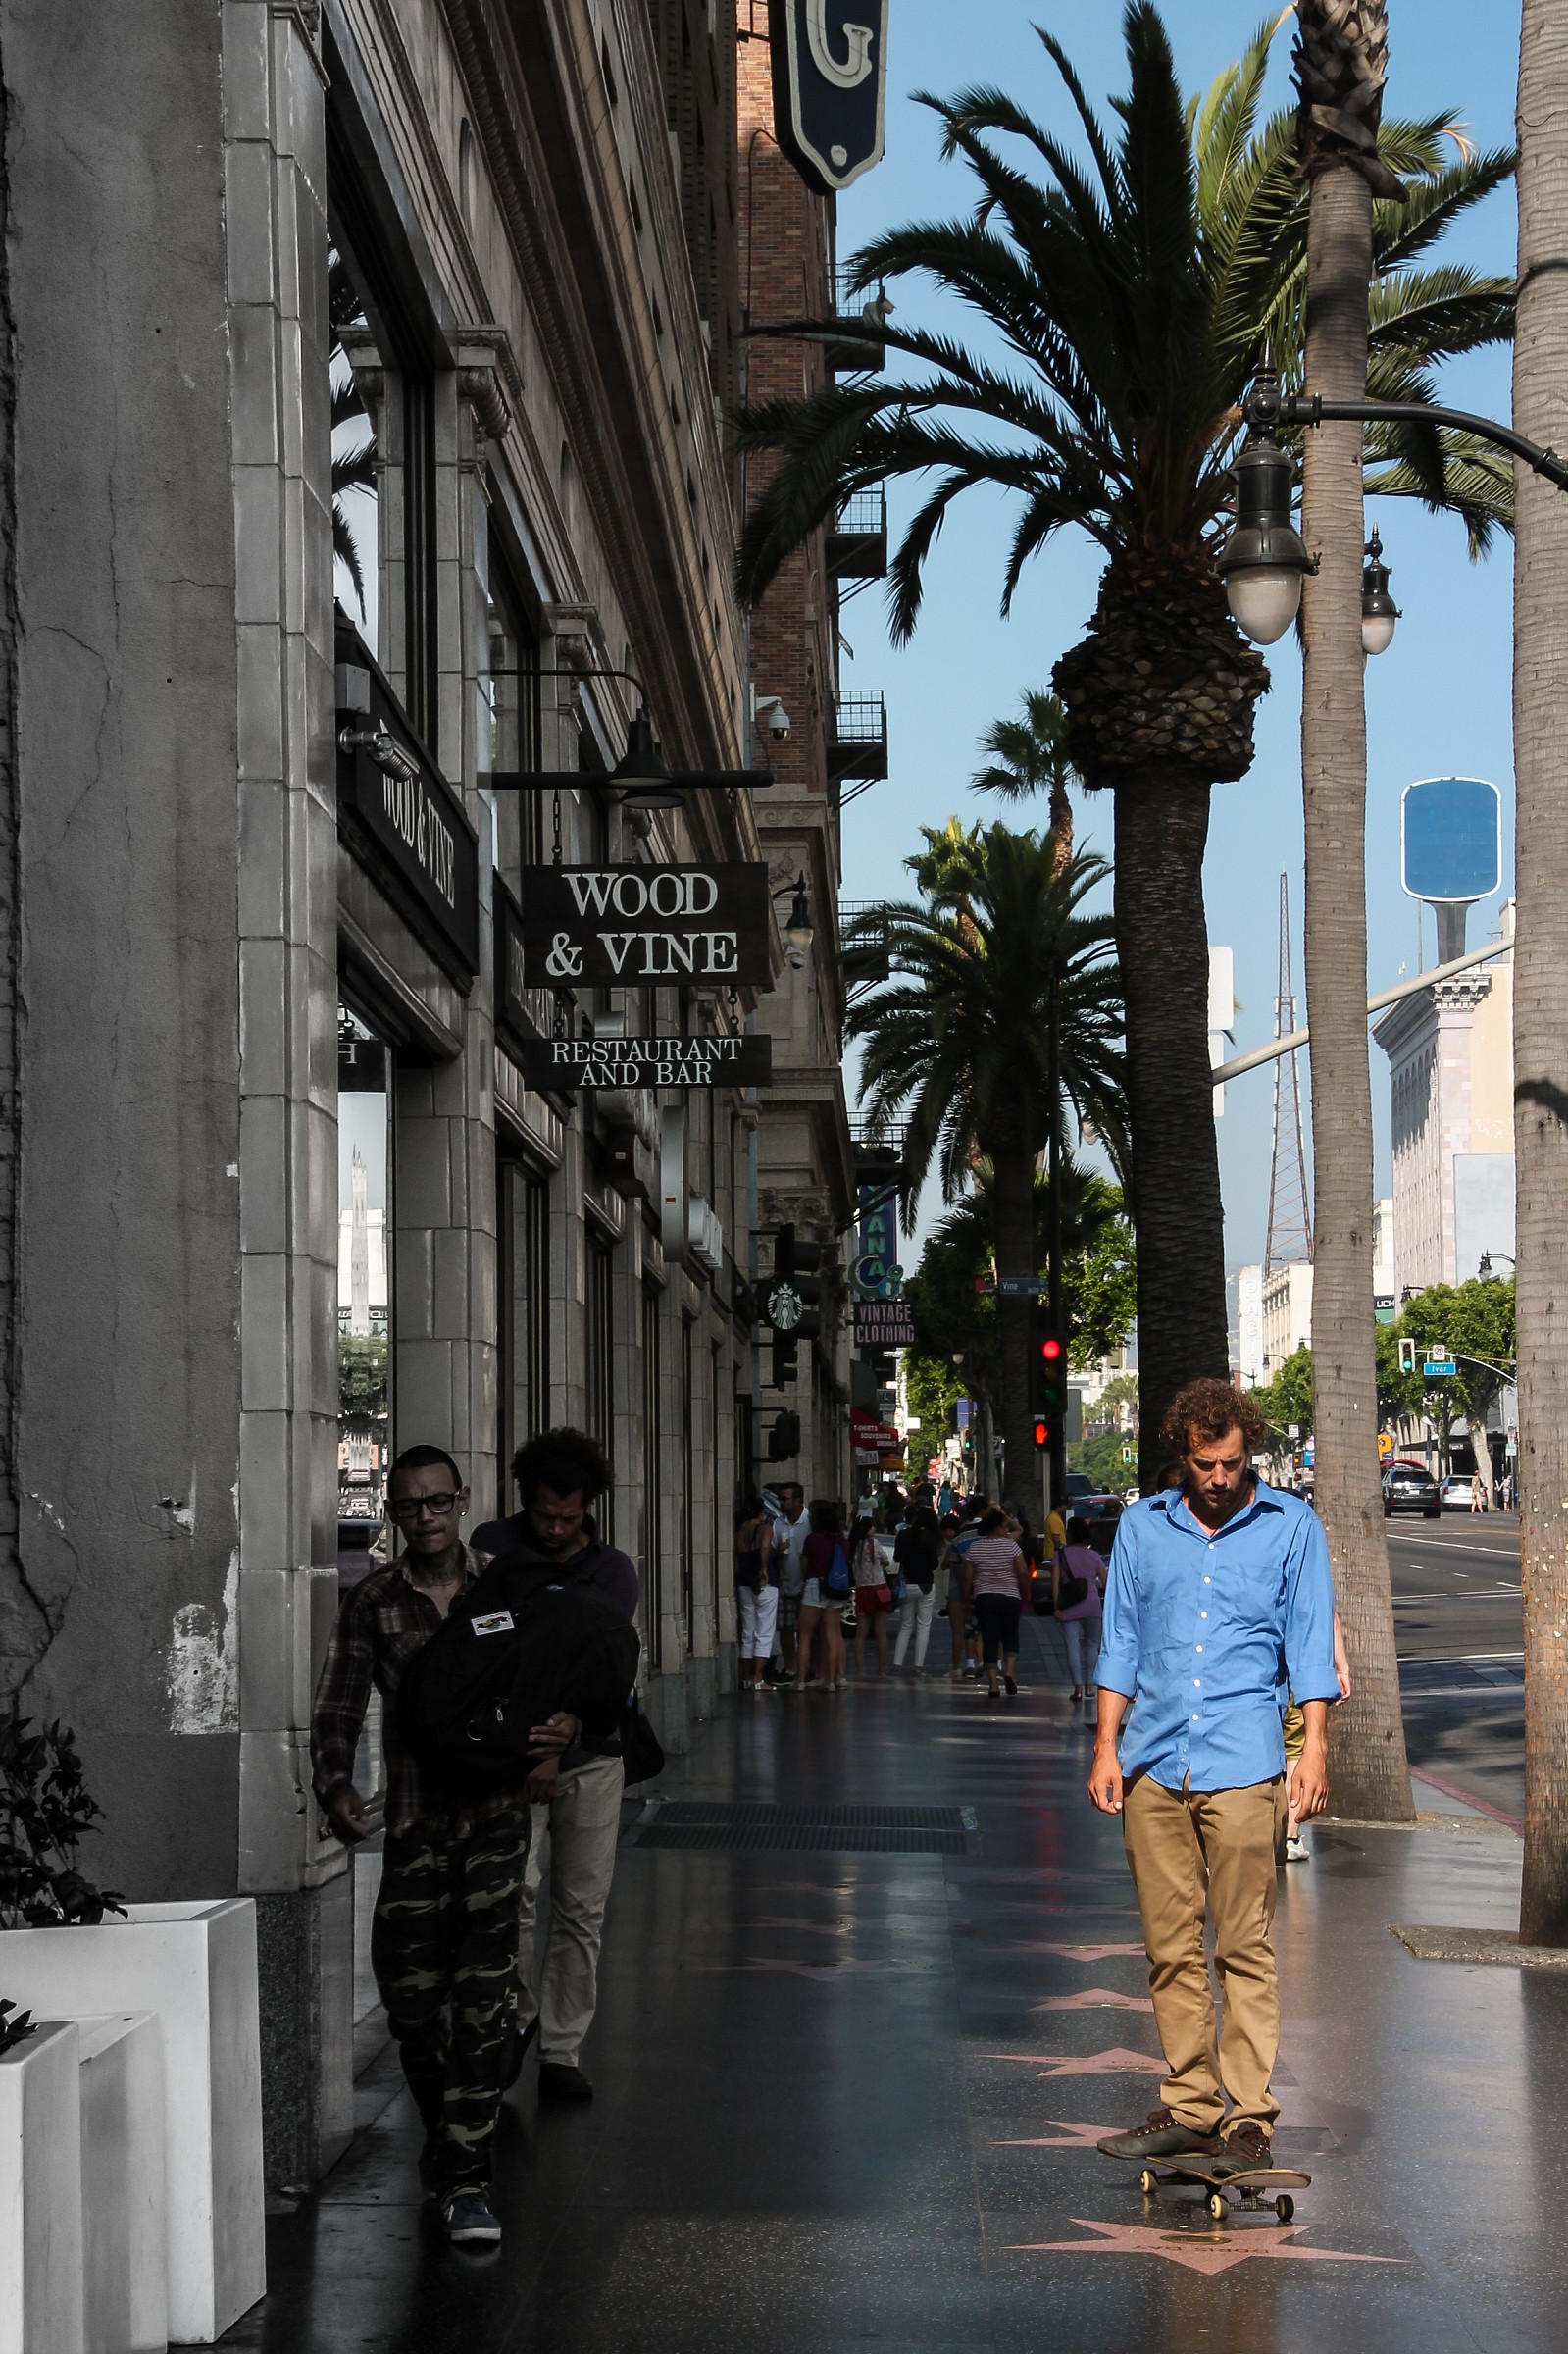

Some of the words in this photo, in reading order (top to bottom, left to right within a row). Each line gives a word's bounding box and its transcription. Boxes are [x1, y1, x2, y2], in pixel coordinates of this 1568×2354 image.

[417, 781, 426, 868] &
[427, 797, 455, 909] VINE
[561, 873, 718, 916] WOOD
[545, 932, 583, 976] &
[596, 932, 738, 974] VINE
[551, 1038, 743, 1063] RESTAURANT
[579, 1063, 640, 1086] AND
[654, 1062, 712, 1085] BAR
[867, 1185, 886, 1277] ANA
[1002, 1281, 1019, 1291] Vine
[859, 1305, 911, 1323] VINTAGE
[856, 1324, 915, 1343] CLOTHING
